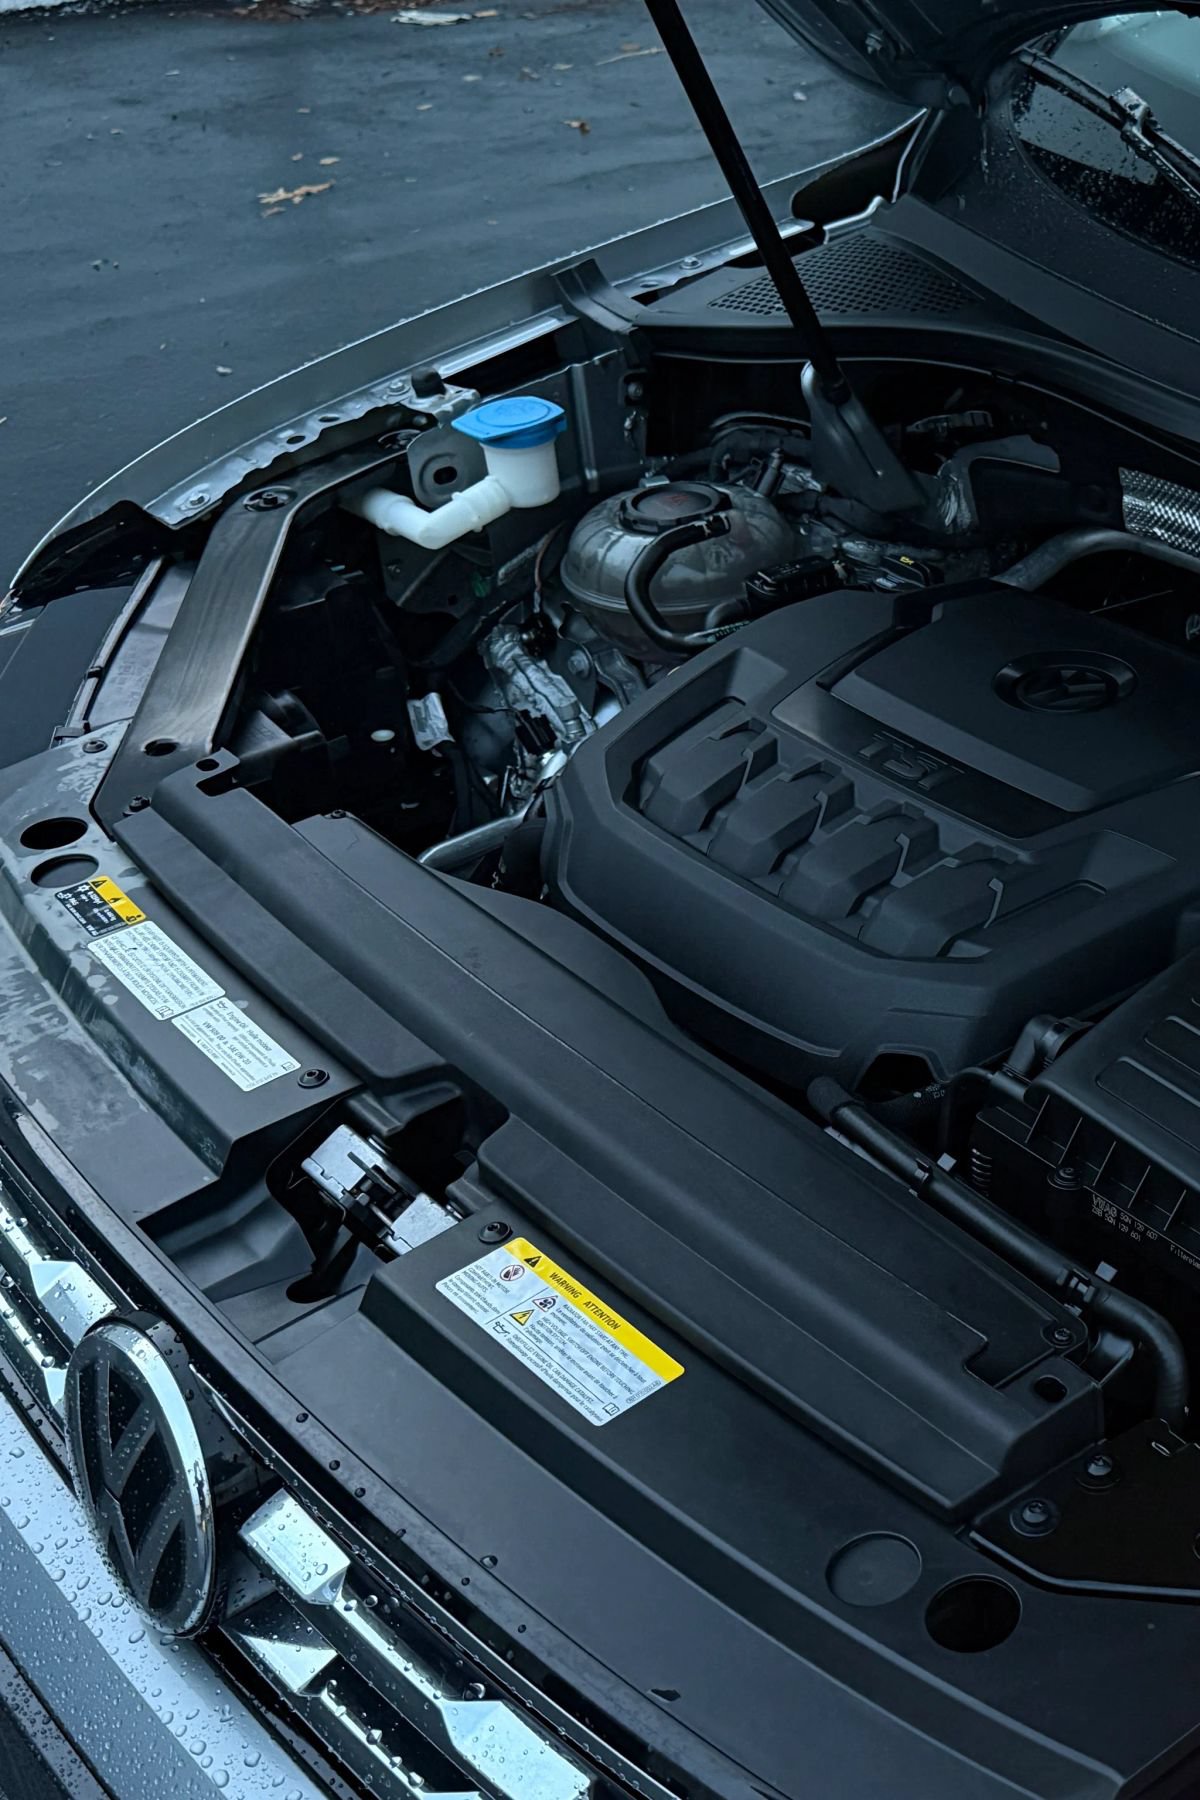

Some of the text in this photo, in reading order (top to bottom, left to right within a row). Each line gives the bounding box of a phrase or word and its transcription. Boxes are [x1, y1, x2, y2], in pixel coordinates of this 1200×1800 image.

[858, 730, 966, 790] TSI
[549, 1272, 621, 1330] WARNING ATTENTION
